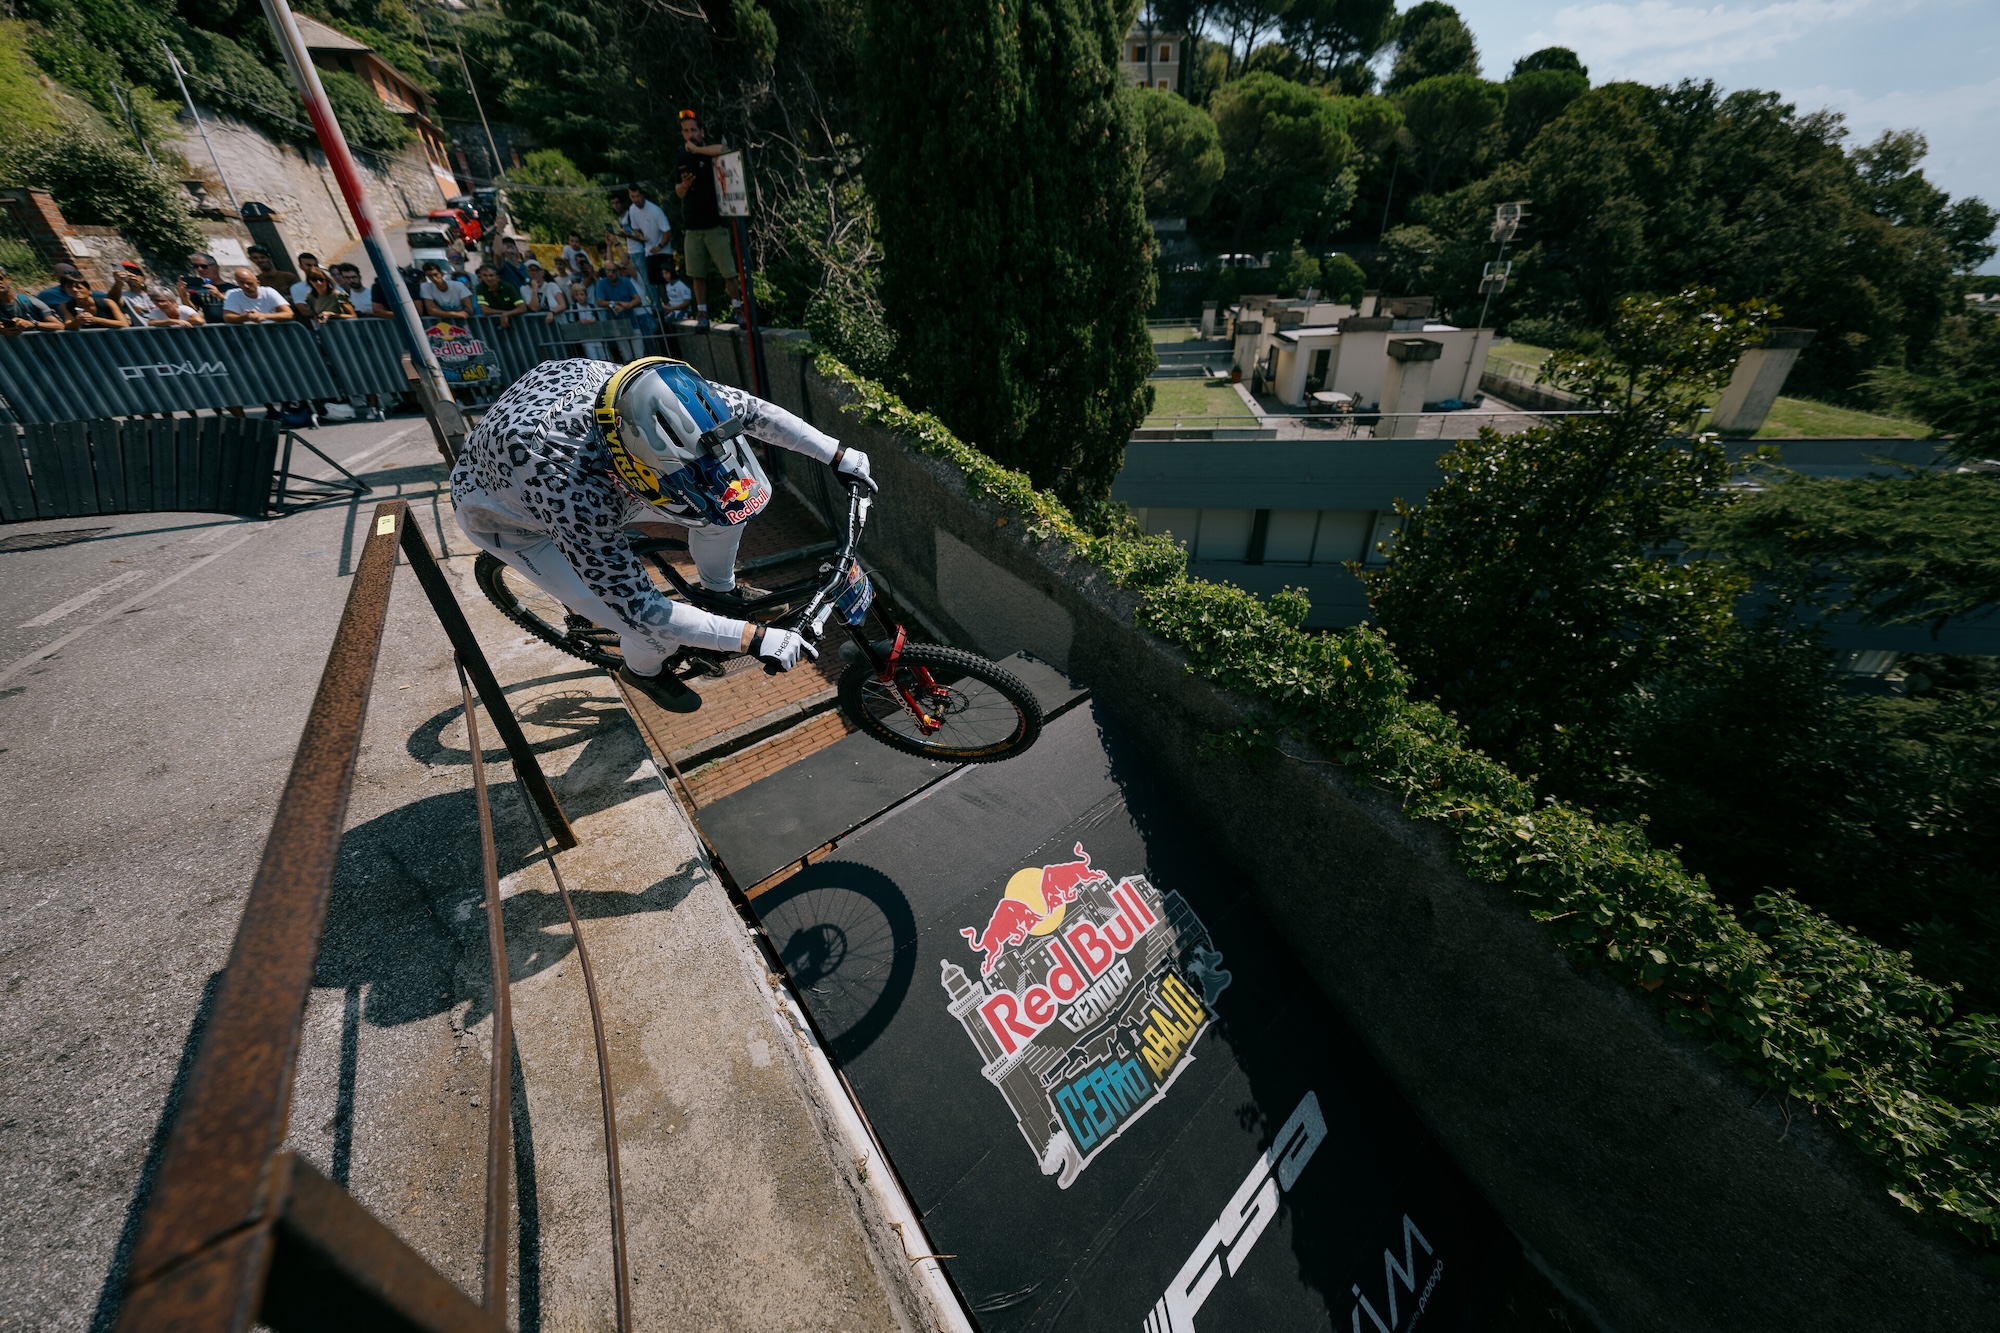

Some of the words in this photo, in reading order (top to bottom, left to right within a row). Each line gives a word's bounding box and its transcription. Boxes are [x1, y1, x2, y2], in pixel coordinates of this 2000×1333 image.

[432, 341, 452, 356] ed
[452, 341, 483, 355] Bull
[727, 502, 753, 523] Red
[749, 487, 769, 510] Bull
[982, 942, 1085, 1054] Red
[1068, 882, 1157, 977] Bull
[1058, 958, 1134, 1034] GENOVA
[1055, 1058, 1152, 1151] CERRO
[1141, 970, 1207, 1080] ABAJO
